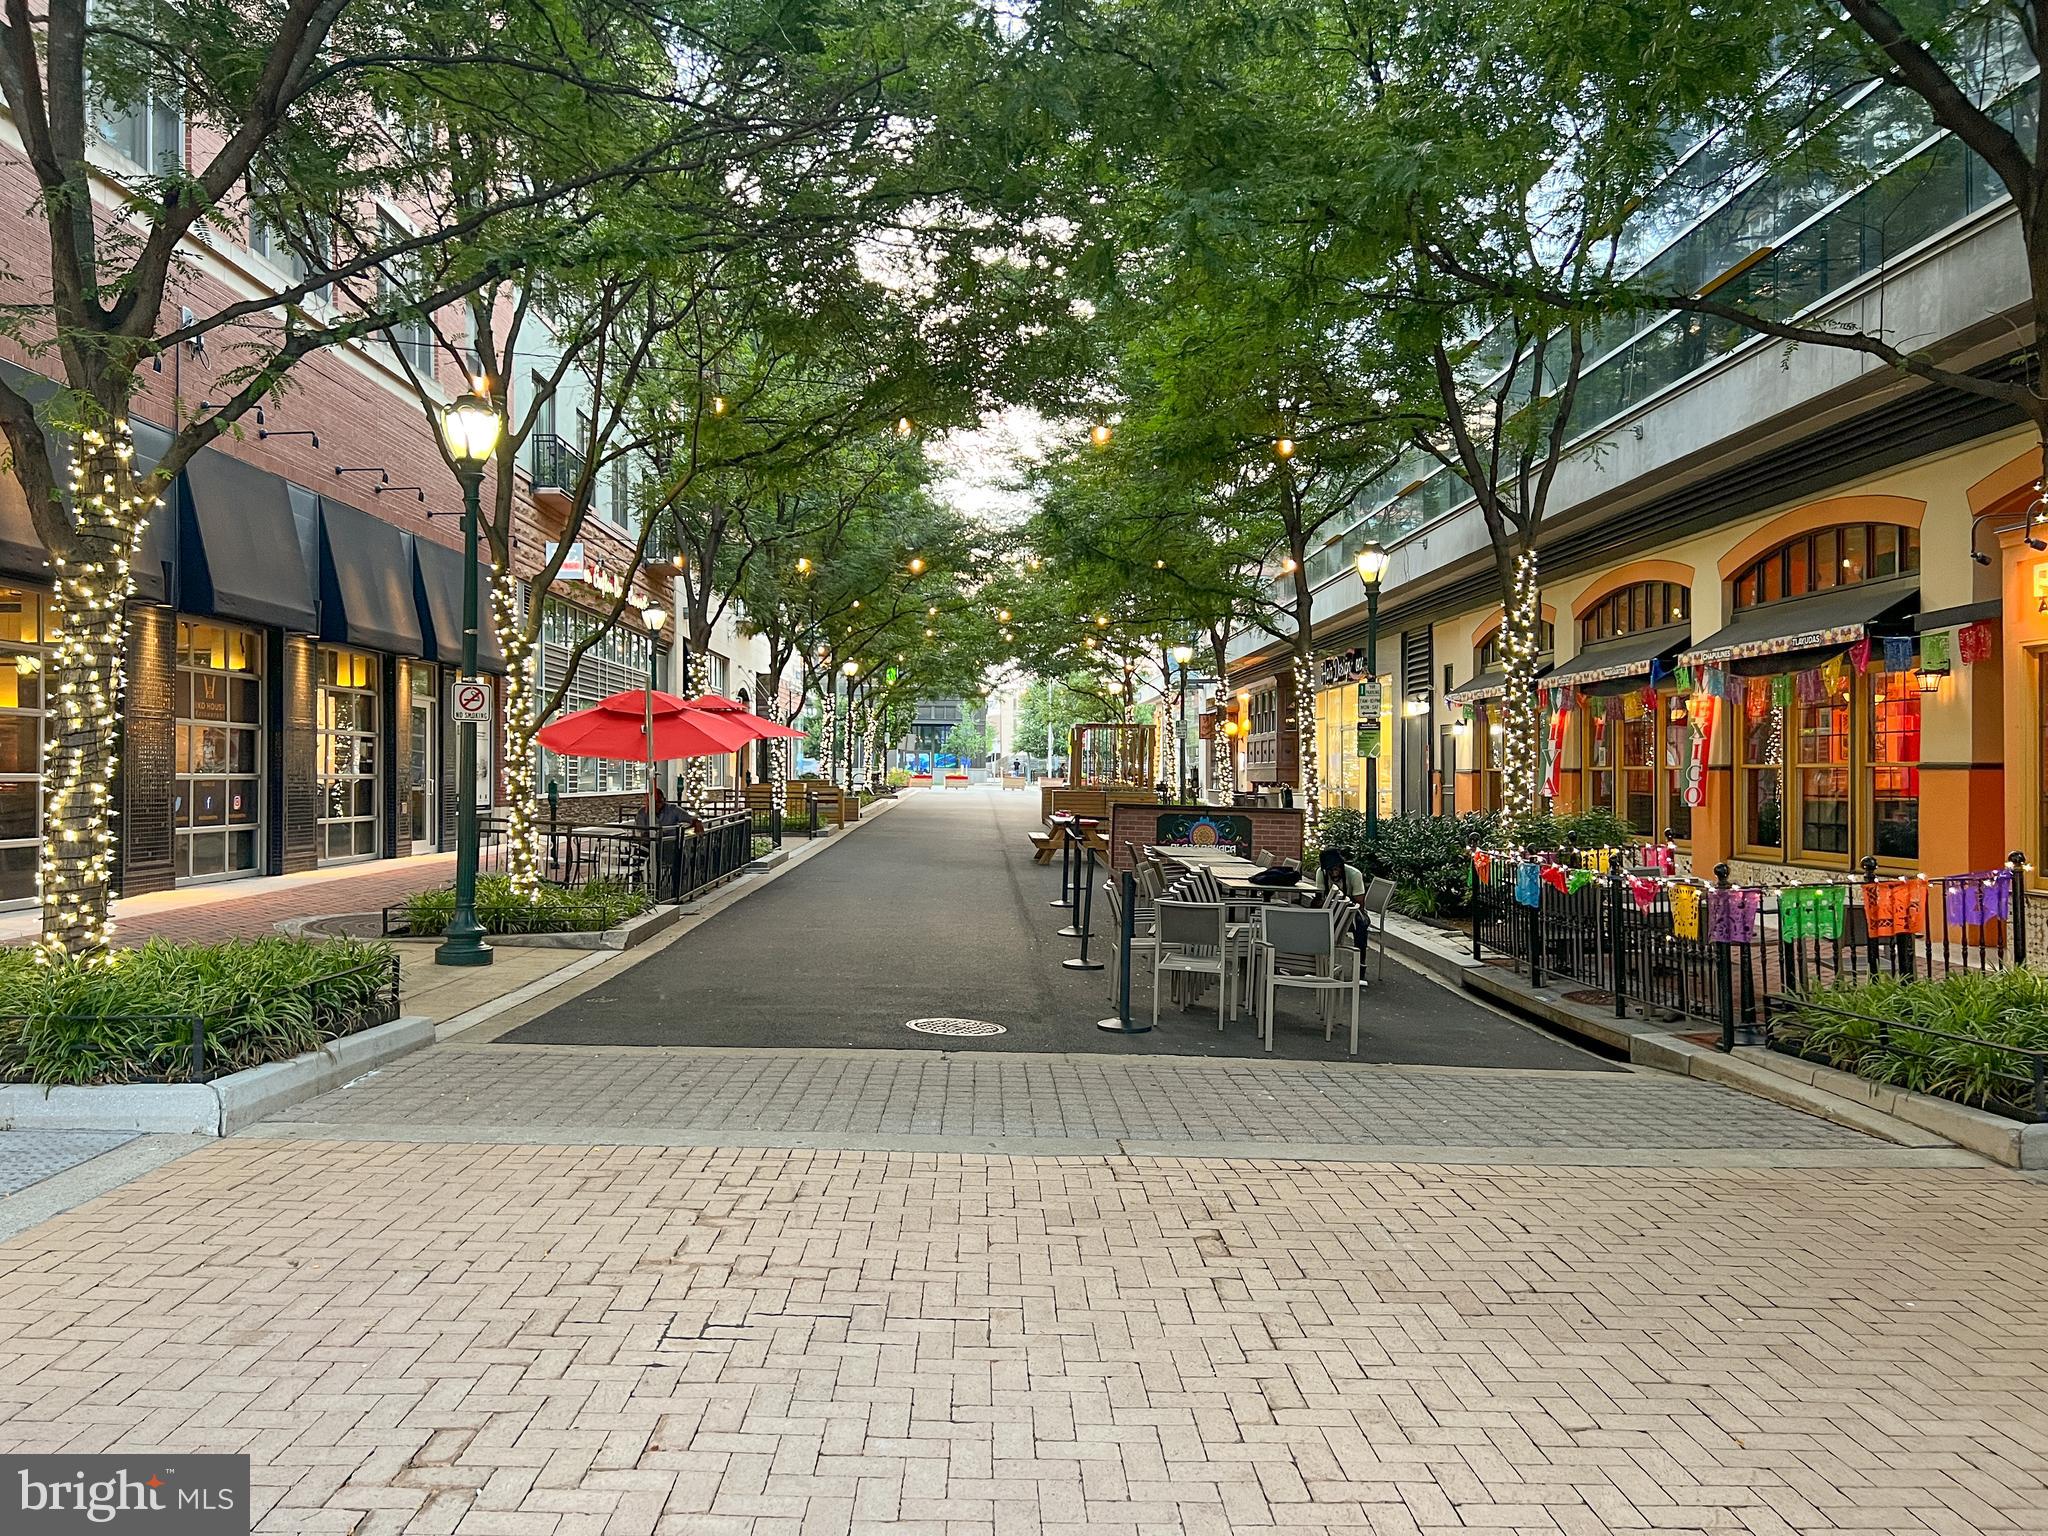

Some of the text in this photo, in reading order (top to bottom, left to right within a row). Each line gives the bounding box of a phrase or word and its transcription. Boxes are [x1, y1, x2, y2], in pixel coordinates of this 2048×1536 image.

[1702, 648, 1731, 661] CHAPULINES
[455, 711, 488, 719] NO SMOKING
